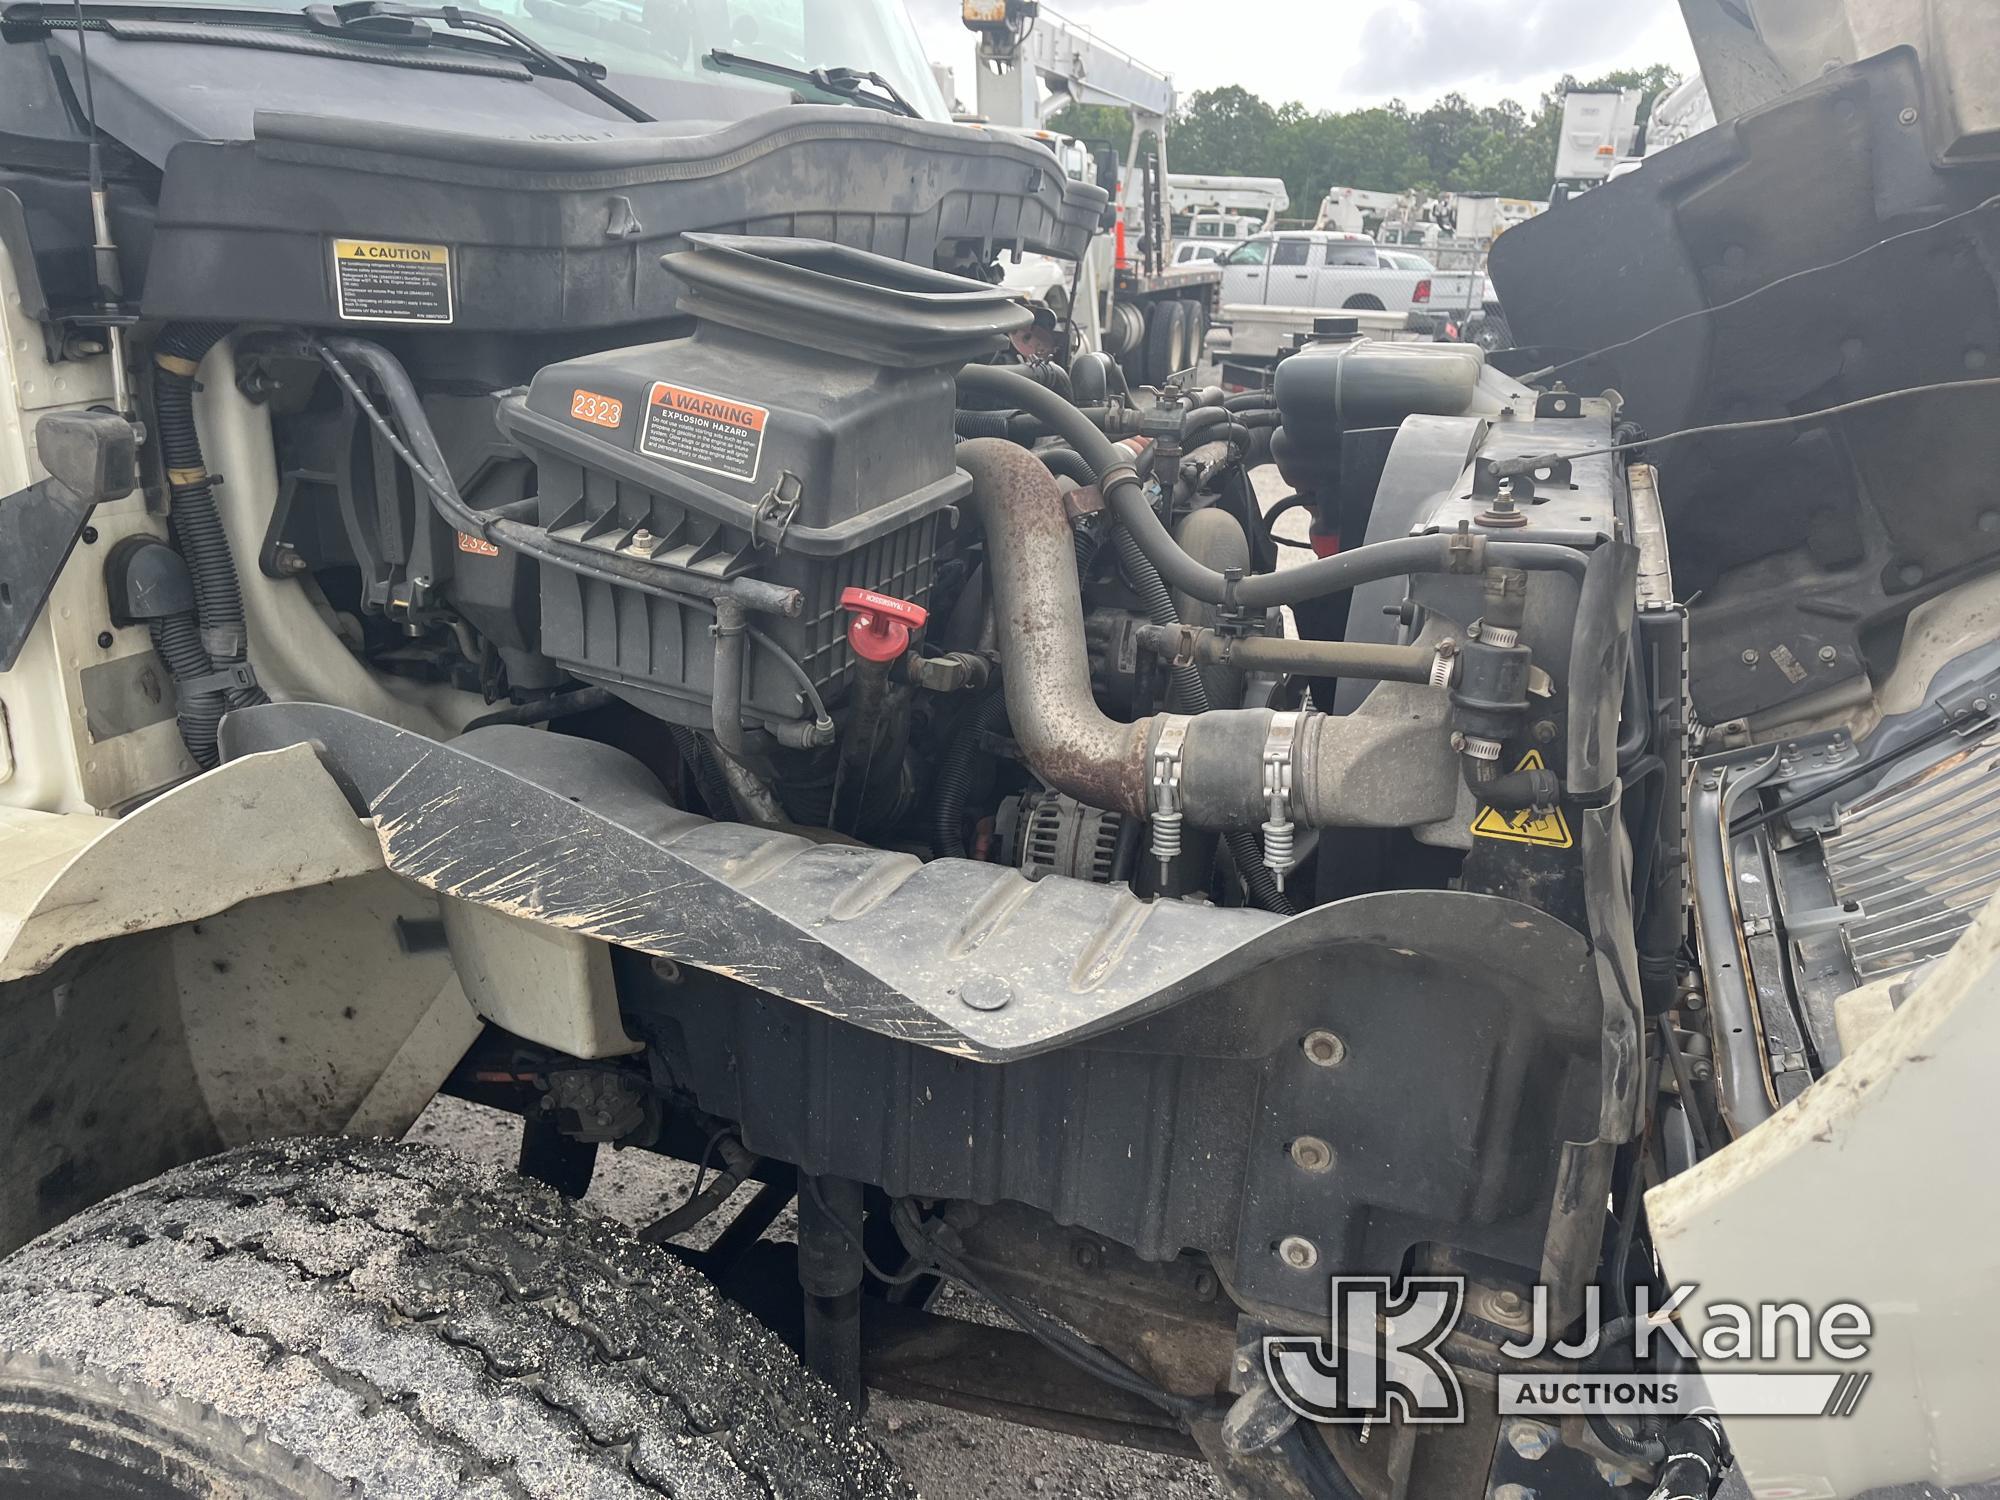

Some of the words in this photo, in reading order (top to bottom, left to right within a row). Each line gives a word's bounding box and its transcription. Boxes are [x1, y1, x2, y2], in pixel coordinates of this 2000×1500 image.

[368, 246, 430, 260] CAUTION
[574, 394, 620, 424] 2323
[675, 394, 753, 425] WARNING
[661, 409, 709, 427] EXPLOSION
[711, 422, 747, 437] HAZARD
[678, 422, 694, 431] volatile
[694, 427, 712, 437] starting
[723, 434, 735, 442] such
[657, 443, 678, 453] personal
[666, 438, 677, 446] Can
[708, 450, 725, 459] engine
[724, 454, 745, 465] damage
[681, 436, 694, 445] plugs
[700, 441, 710, 449] grid
[710, 438, 727, 447] engine
